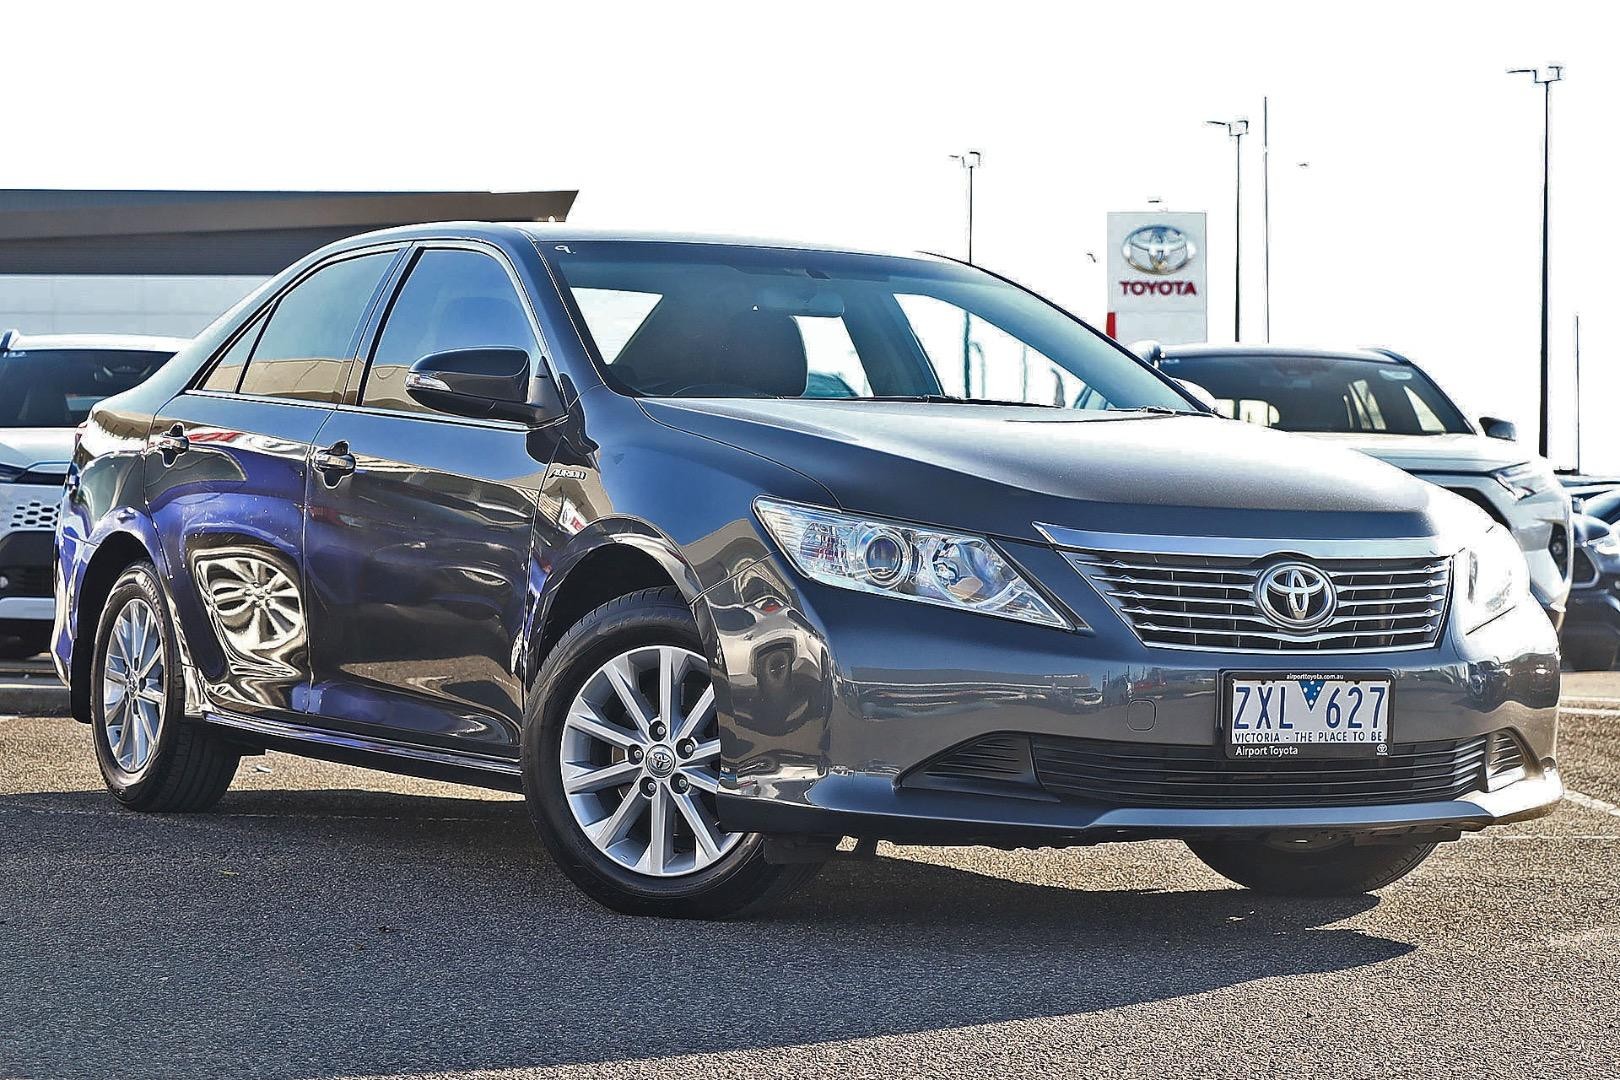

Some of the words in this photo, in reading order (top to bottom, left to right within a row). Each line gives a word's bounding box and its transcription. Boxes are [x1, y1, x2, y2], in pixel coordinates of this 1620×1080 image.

[1119, 281, 1197, 296] TOYOTA
[1233, 686, 1294, 730] ZXL
[1325, 686, 1386, 730] 627
[1234, 732, 1280, 743] VICTORIA
[1295, 731, 1313, 742] THE
[1318, 731, 1348, 742] PLACE
[1353, 731, 1366, 742] TO
[1235, 746, 1268, 758] Airport
[1269, 746, 1298, 757] Toyota
